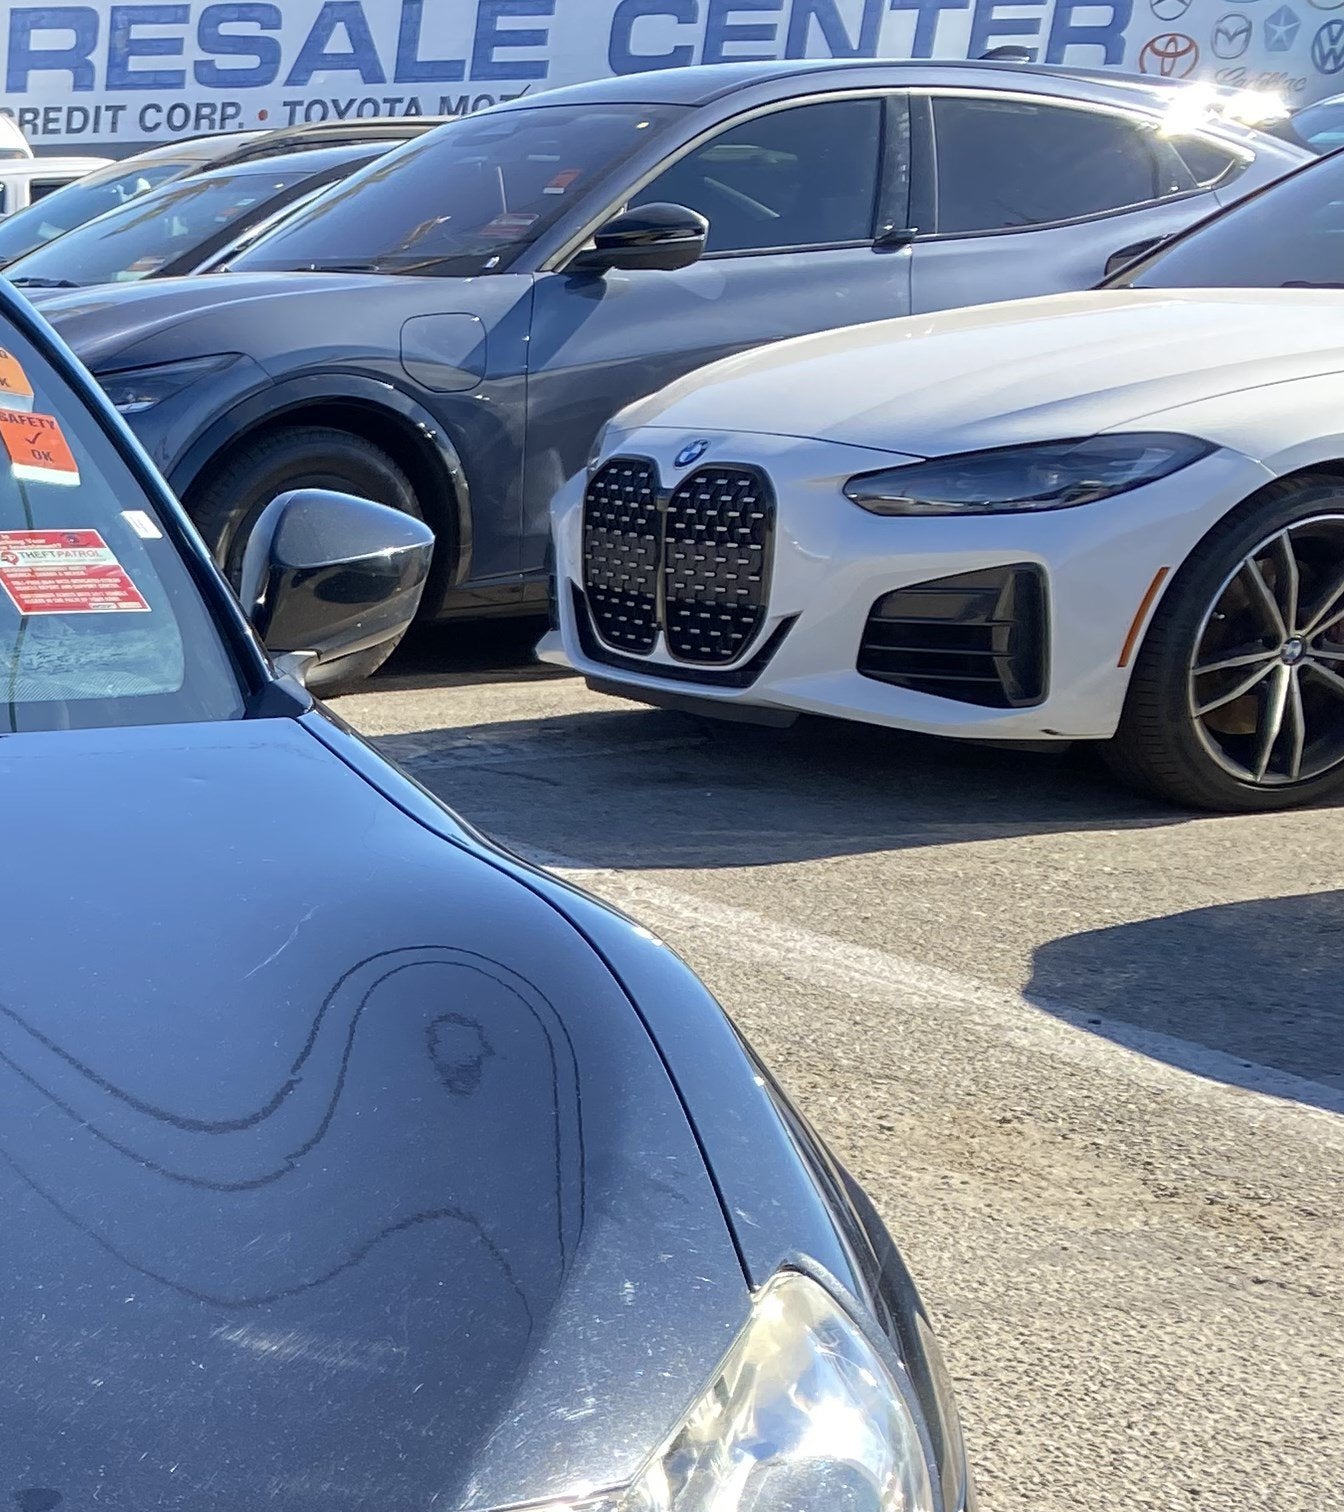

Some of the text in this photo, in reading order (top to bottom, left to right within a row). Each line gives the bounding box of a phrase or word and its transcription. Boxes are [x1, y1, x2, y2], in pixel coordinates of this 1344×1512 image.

[5, 0, 550, 93] RESALE
[607, 0, 1133, 77] CENTER
[138, 101, 245, 133] CORP.
[282, 96, 424, 127] TOYOTA
[30, 449, 55, 463] OK
